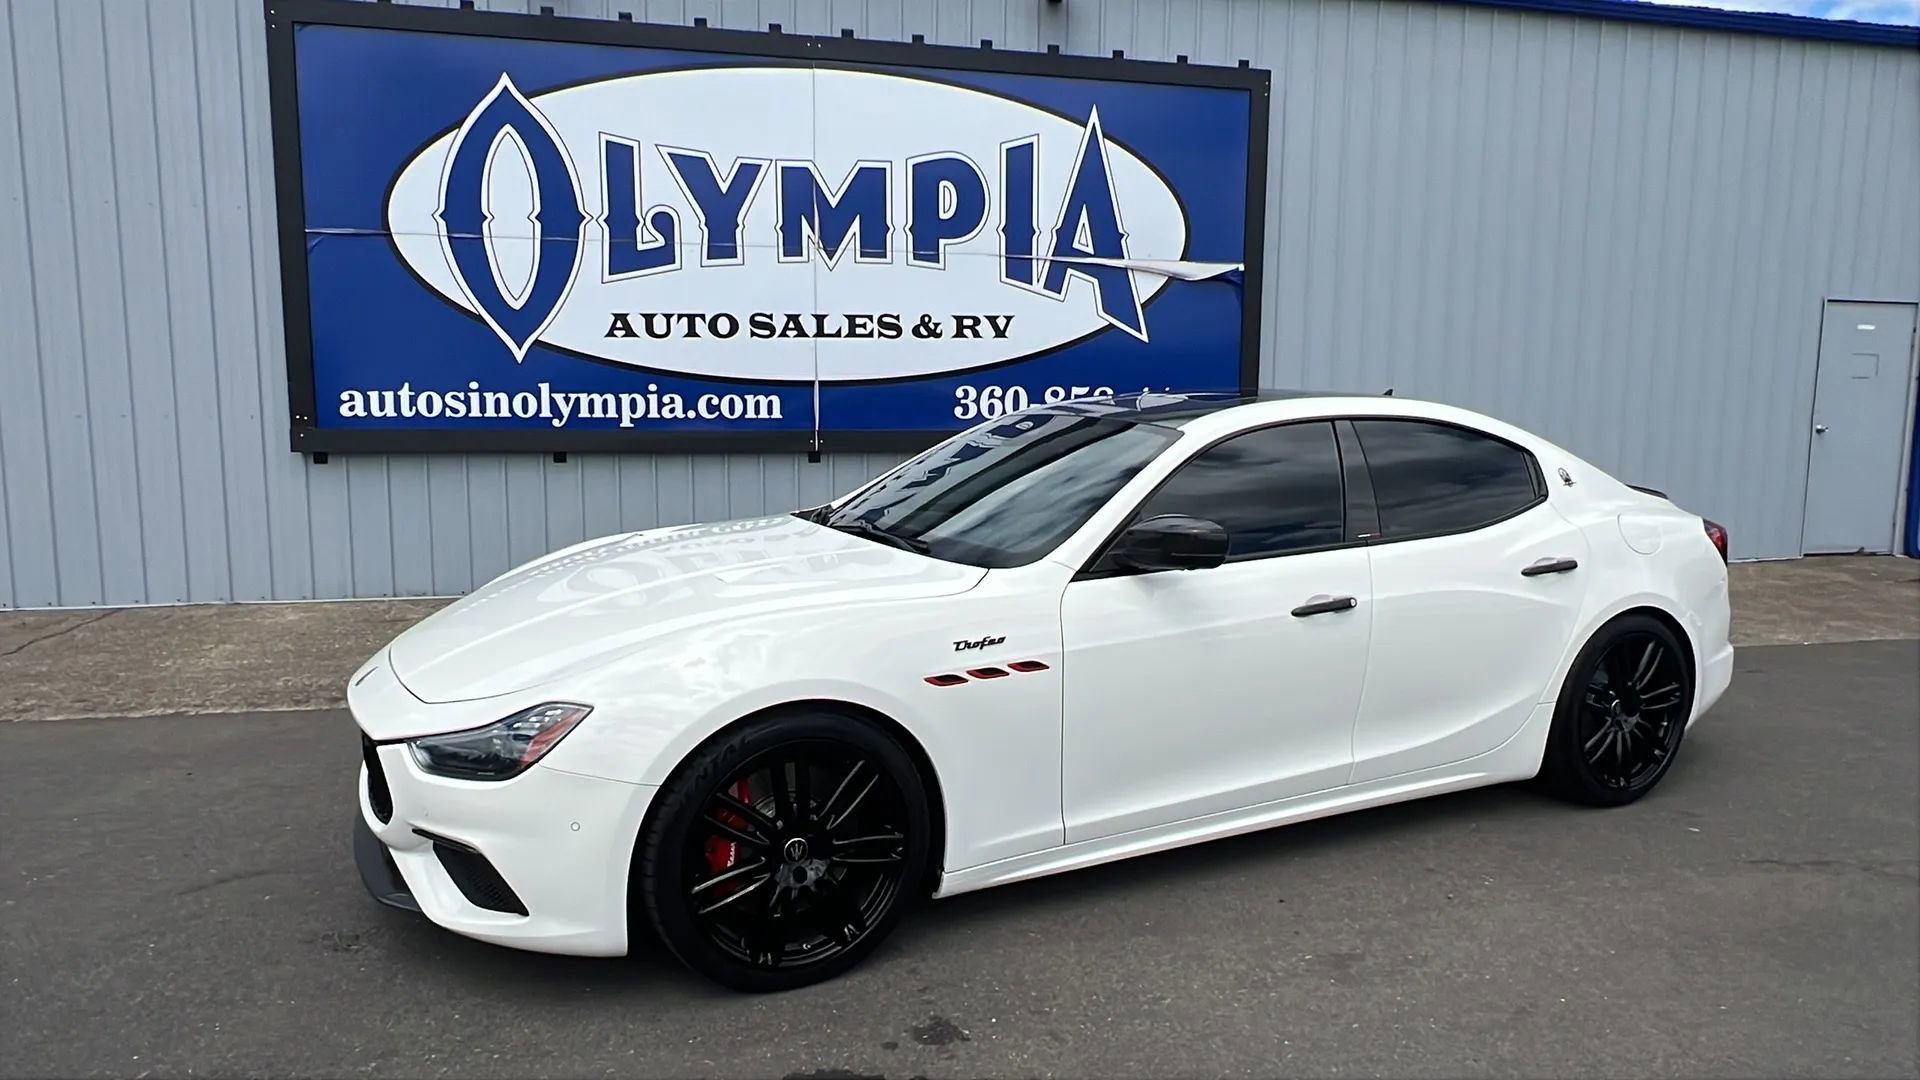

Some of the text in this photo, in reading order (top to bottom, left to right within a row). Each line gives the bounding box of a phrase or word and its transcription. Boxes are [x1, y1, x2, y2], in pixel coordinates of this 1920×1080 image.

[431, 71, 1149, 364] OLYMPIA
[604, 312, 1016, 340] AUTO SALES & RV
[338, 380, 784, 428] autosinolympia.com
[952, 635, 1007, 652] Trofeo
